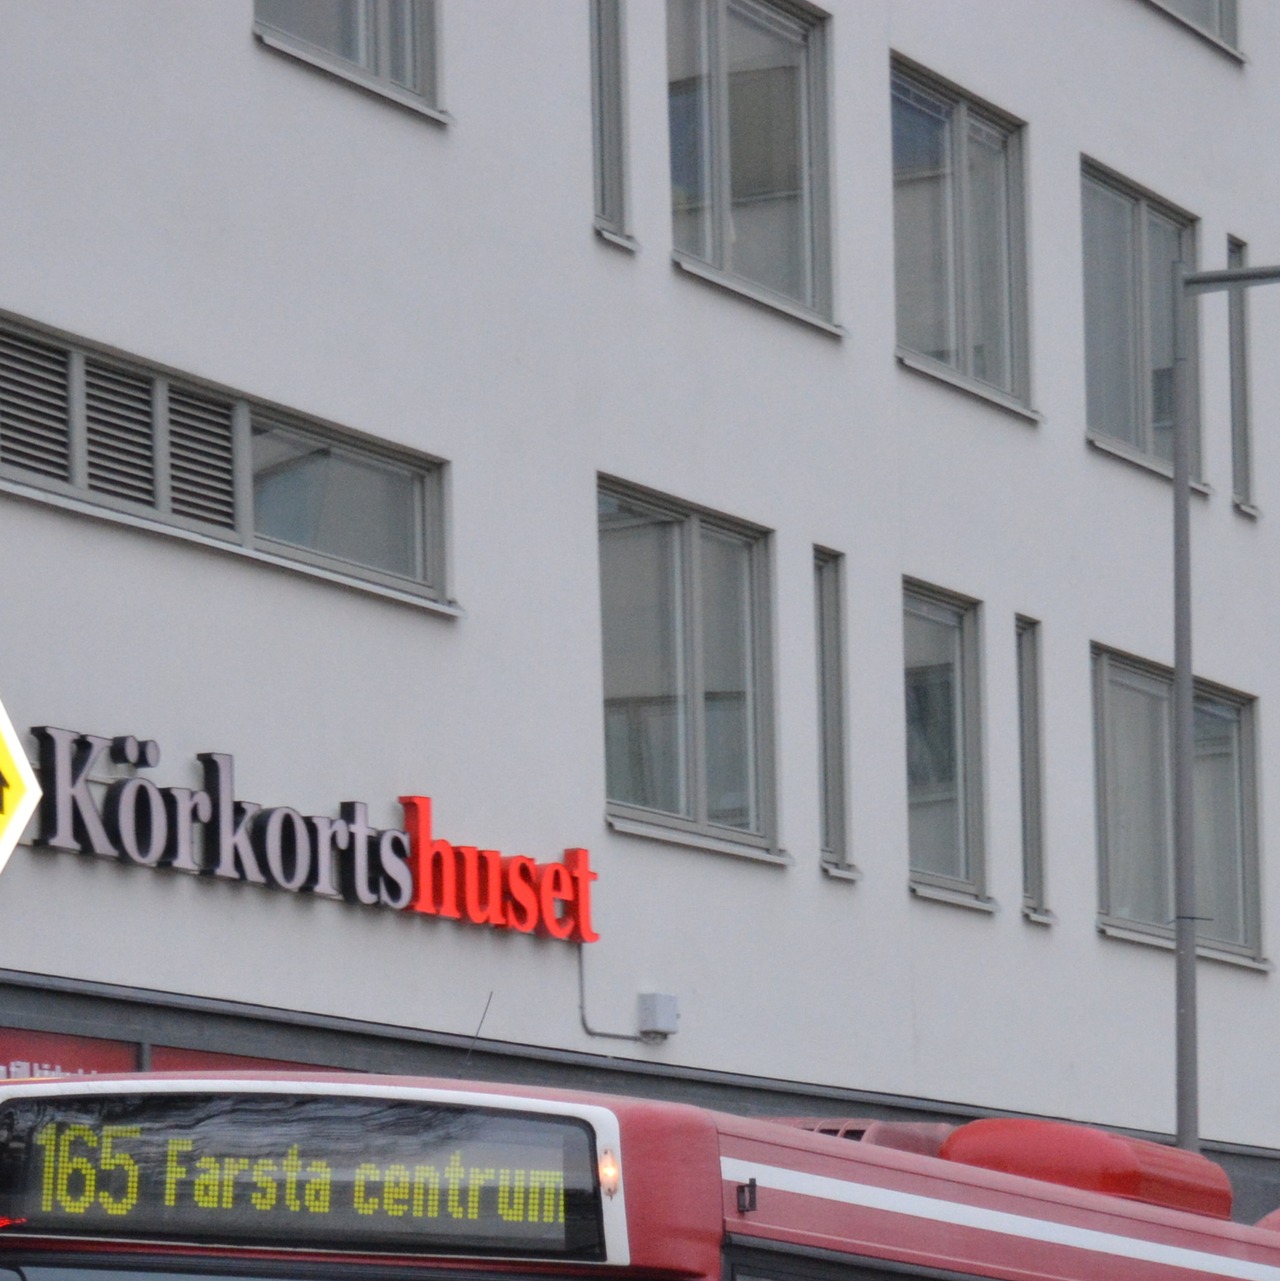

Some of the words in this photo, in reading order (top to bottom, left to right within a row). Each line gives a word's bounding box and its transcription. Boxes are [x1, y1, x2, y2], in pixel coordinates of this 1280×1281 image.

[31, 726, 600, 944] Körkortshuset
[37, 1123, 140, 1215] 165
[164, 1138, 331, 1213] Farsta
[354, 1150, 565, 1224] centrum
